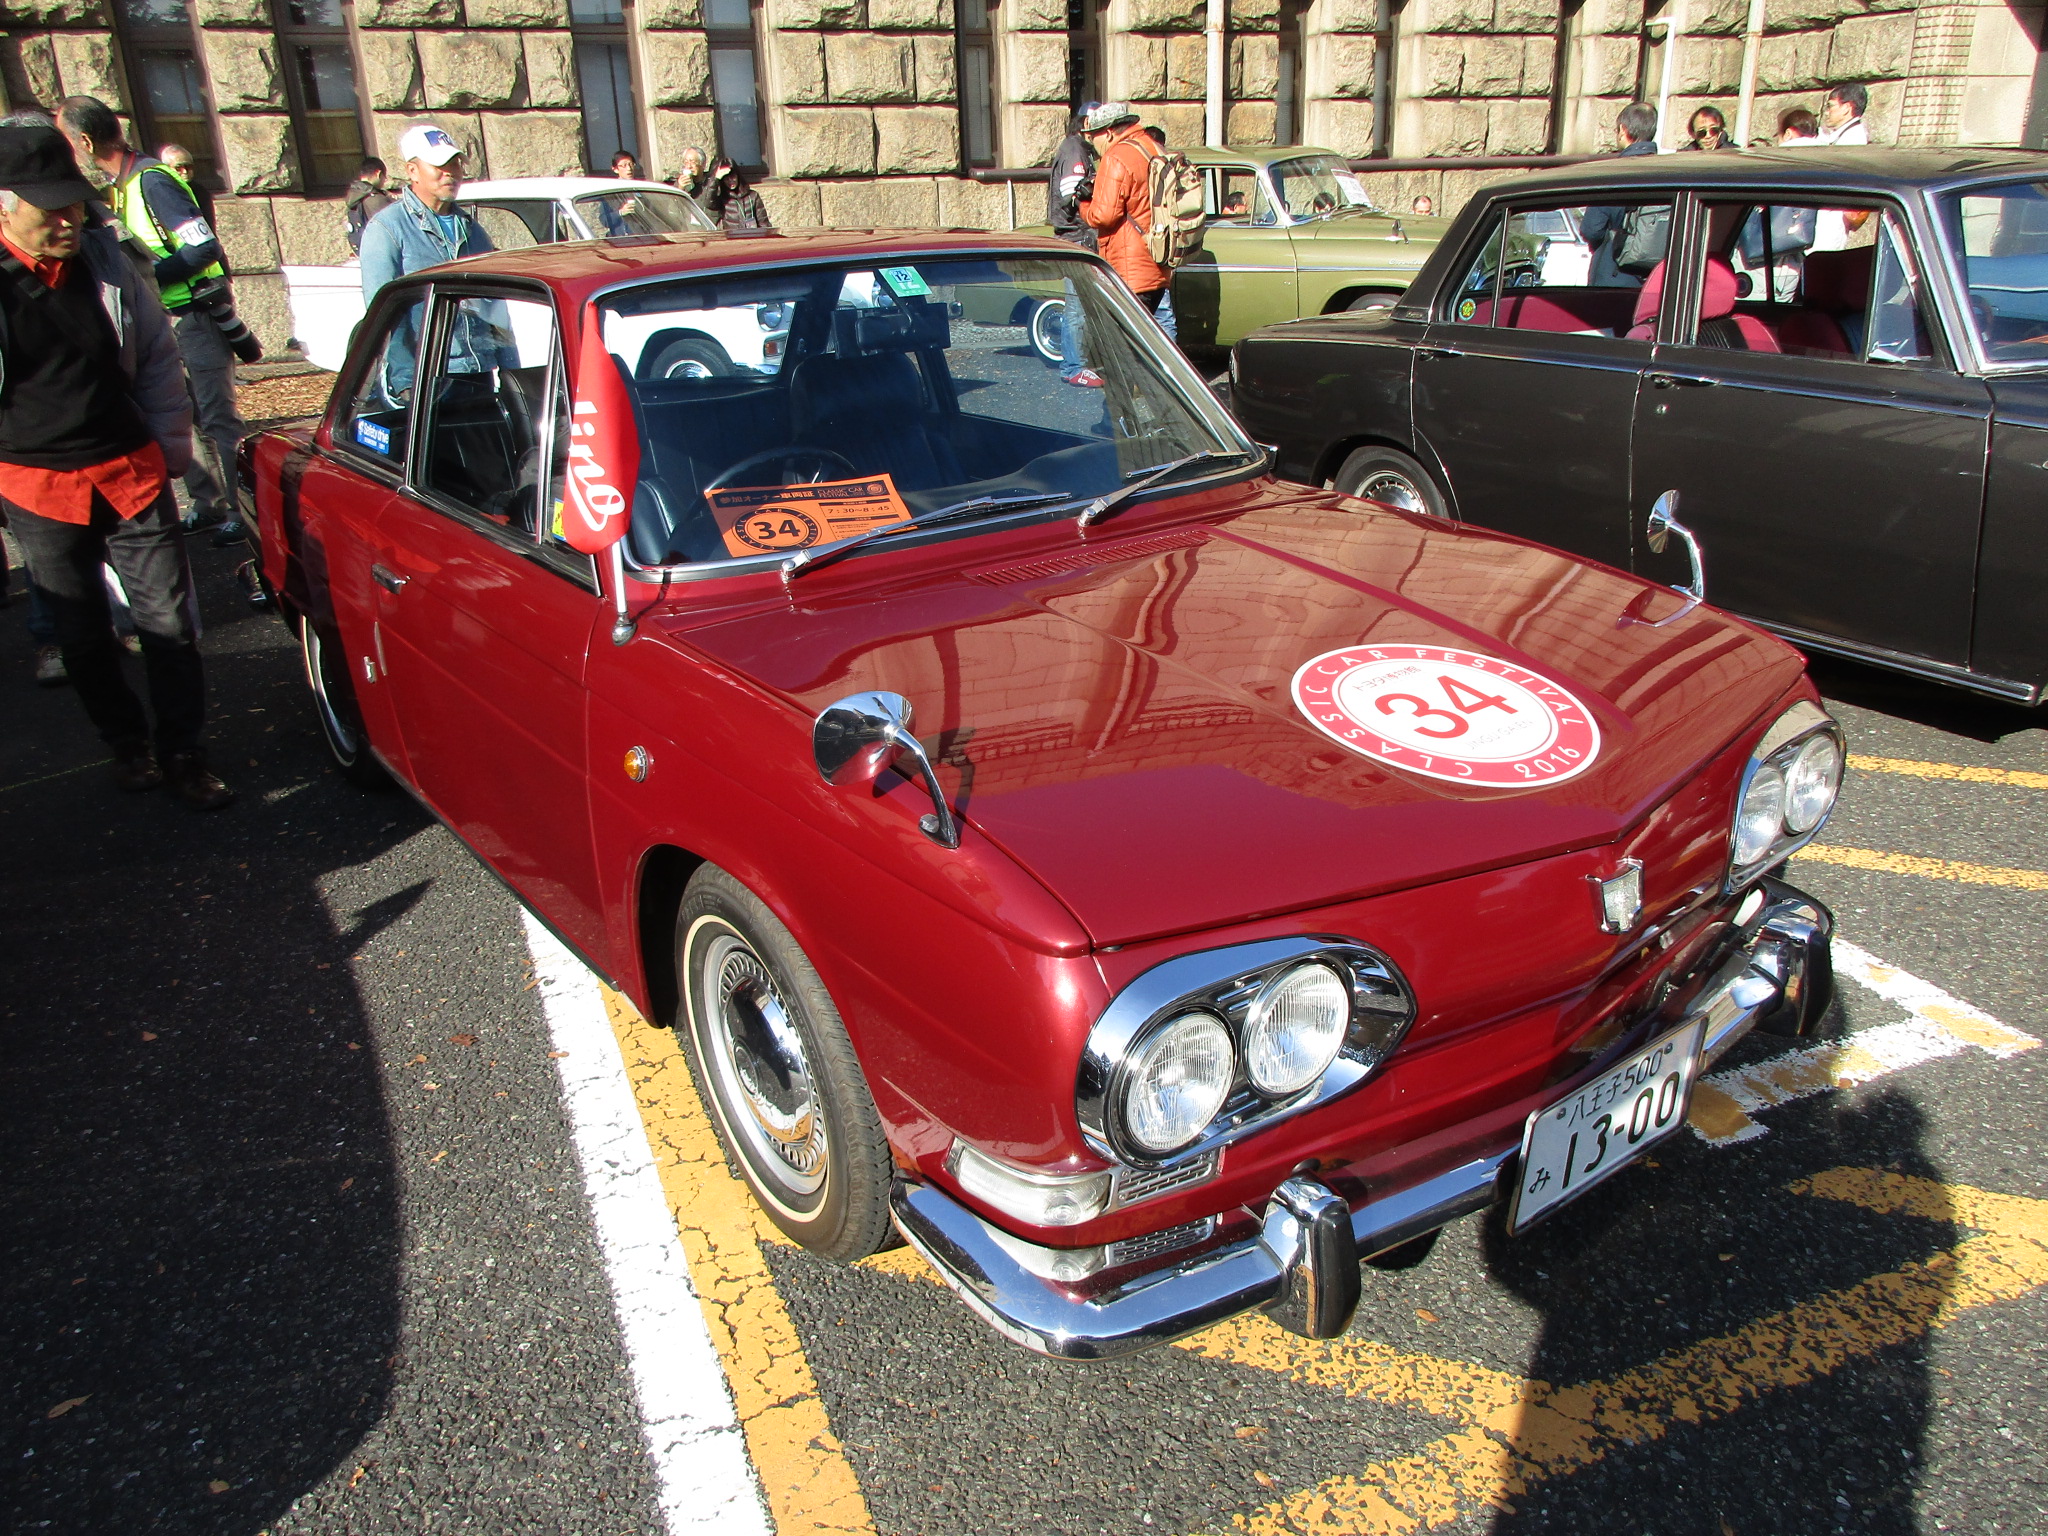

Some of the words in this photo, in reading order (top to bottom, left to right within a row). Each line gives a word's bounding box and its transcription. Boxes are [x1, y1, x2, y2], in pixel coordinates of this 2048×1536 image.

[753, 519, 801, 540] 34
[1317, 650, 1389, 675] CAR
[1416, 649, 1584, 726] FESTIVAL
[1311, 685, 1473, 777] CLASSIC
[1374, 675, 1519, 739] 34
[1514, 745, 1581, 779] 2016
[1529, 1167, 1551, 1194] み
[1562, 1071, 1681, 1190] 13-00
